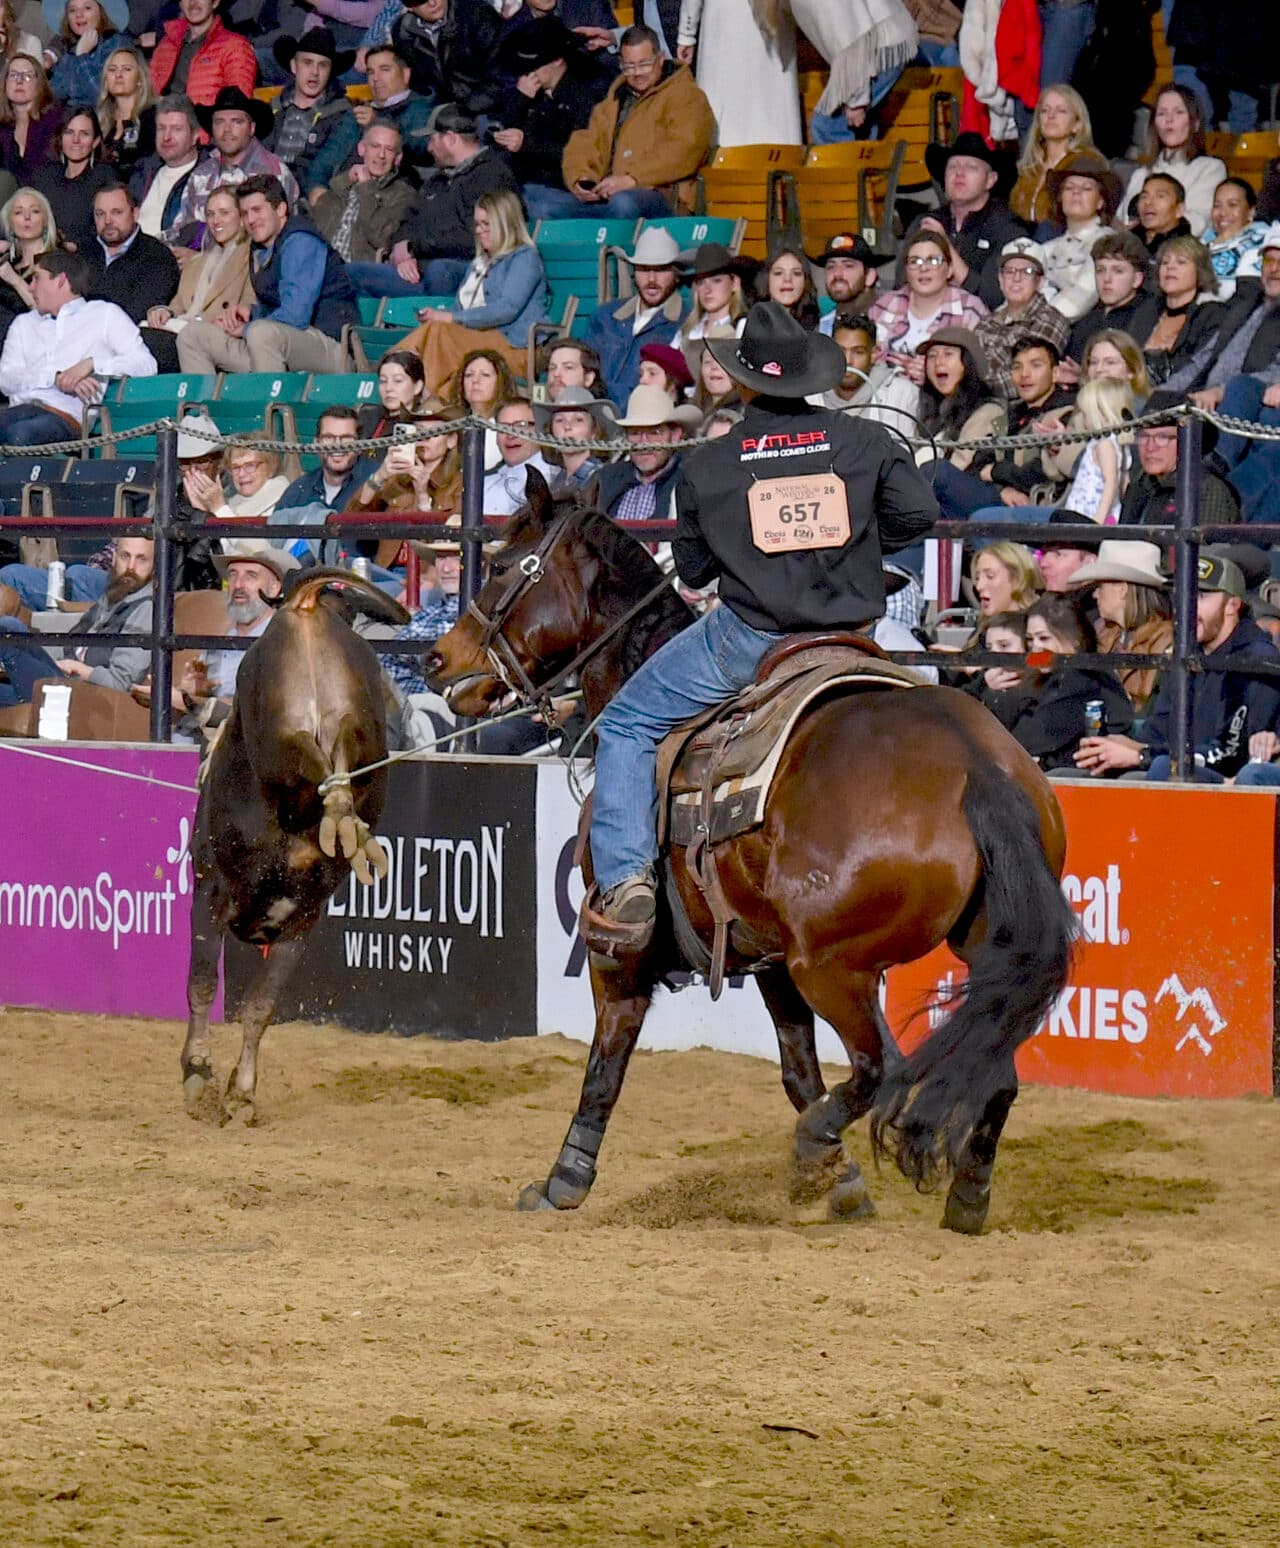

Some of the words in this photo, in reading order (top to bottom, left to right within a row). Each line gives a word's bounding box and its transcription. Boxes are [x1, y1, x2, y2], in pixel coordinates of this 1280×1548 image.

[596, 227, 607, 243] 9
[692, 224, 708, 241] 10
[177, 382, 188, 397] 8
[270, 380, 282, 397] 9
[357, 381, 374, 398] 10
[741, 431, 825, 451] RATTLER
[740, 450, 779, 462] NOTHING
[780, 446, 806, 457] COMES
[806, 443, 831, 454] CLOSE
[30, 465, 41, 481] 8
[125, 466, 136, 482] 9
[760, 492, 772, 502] 20
[824, 486, 835, 495] 26
[779, 502, 821, 524] 657
[344, 930, 452, 974] WHISKY
